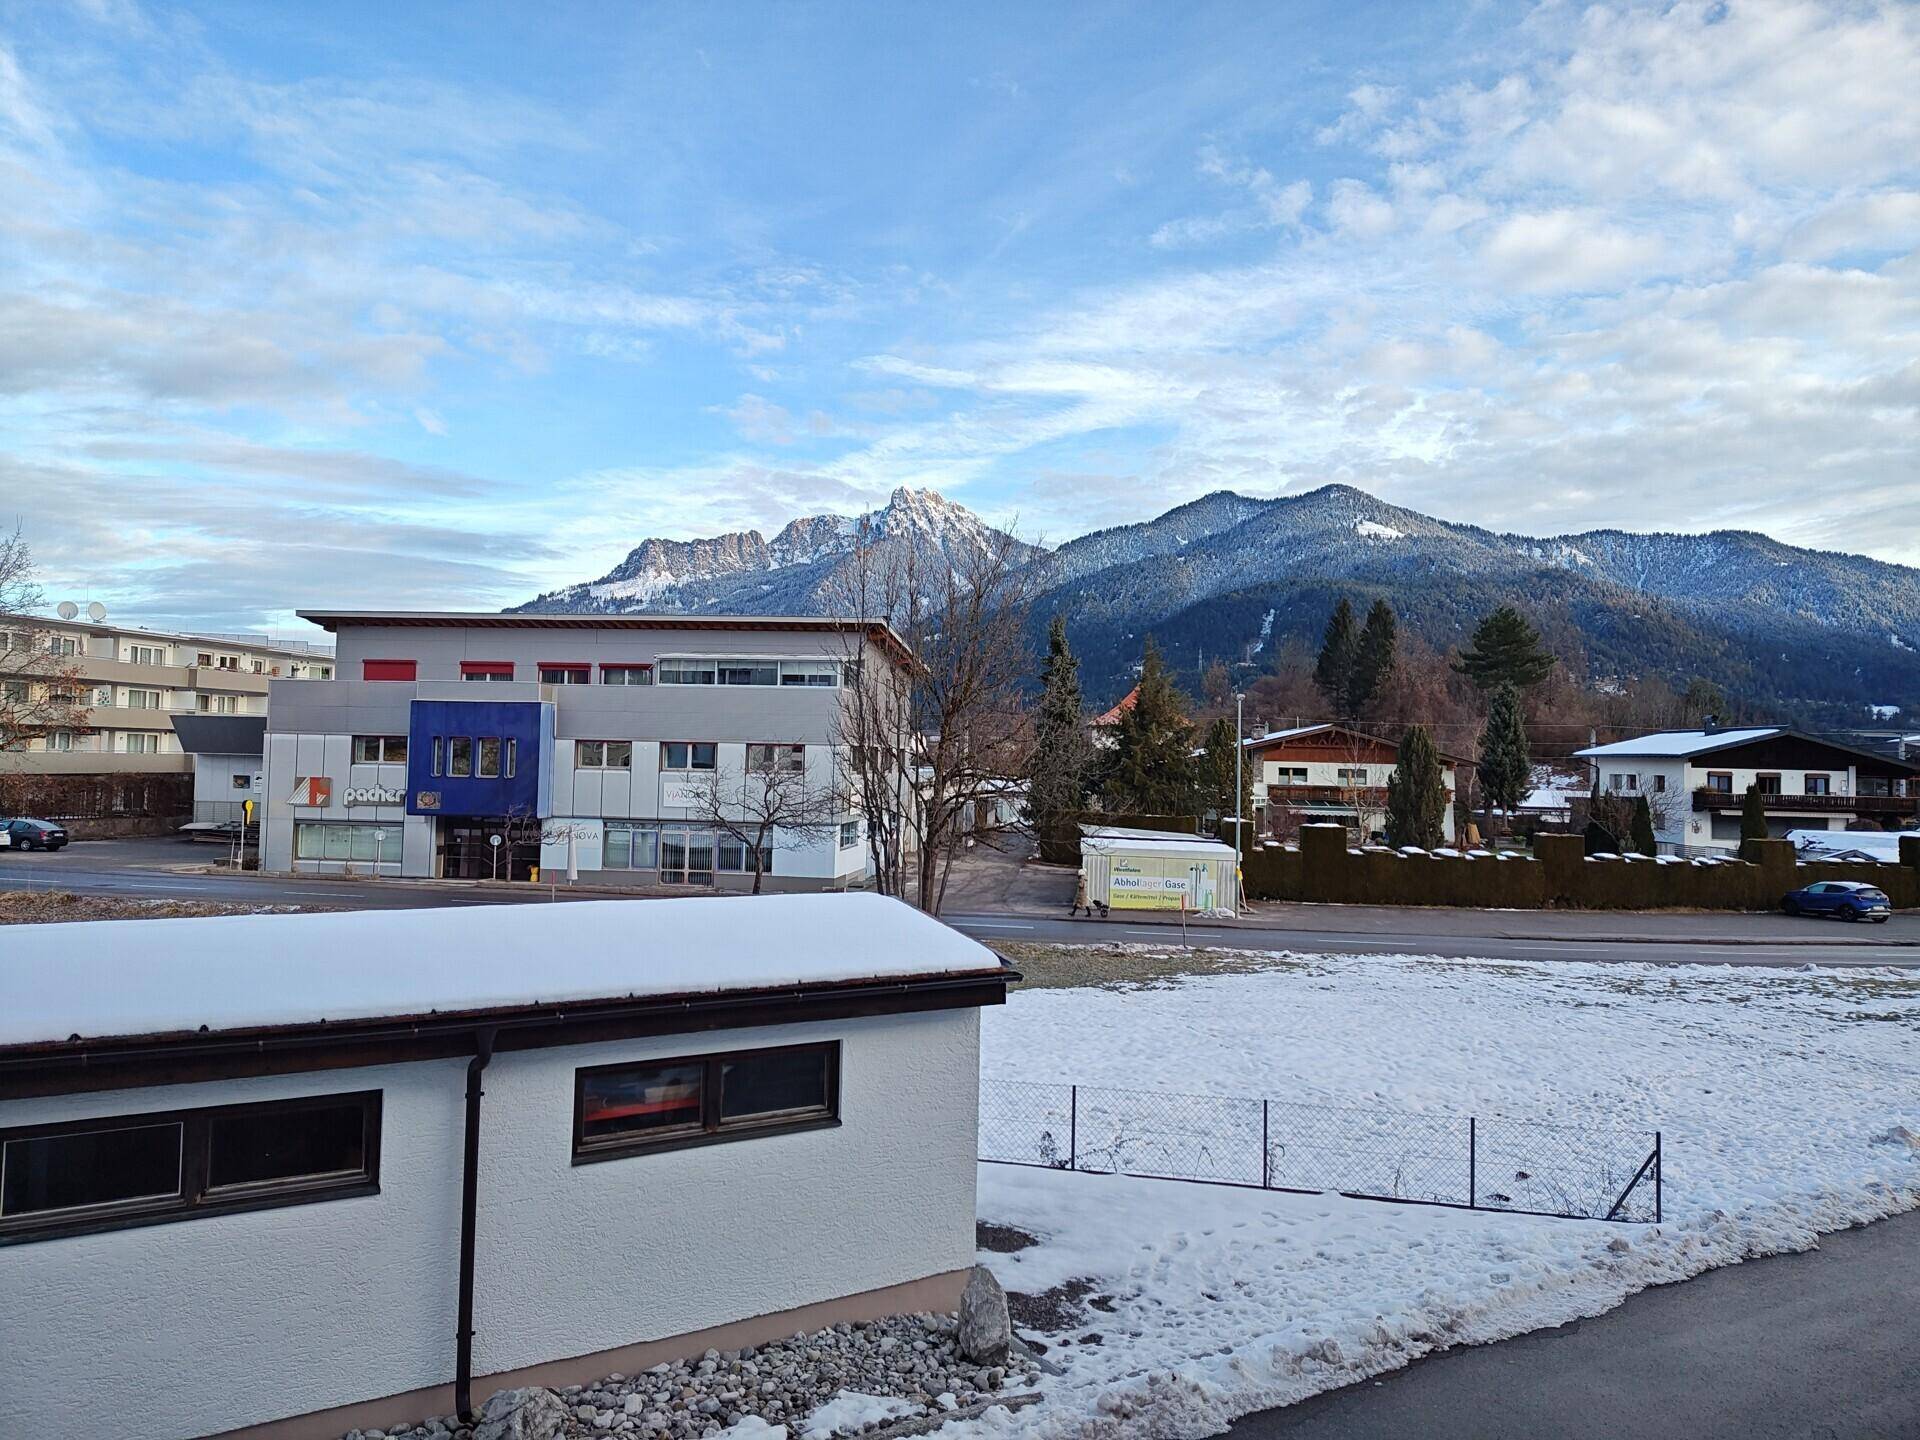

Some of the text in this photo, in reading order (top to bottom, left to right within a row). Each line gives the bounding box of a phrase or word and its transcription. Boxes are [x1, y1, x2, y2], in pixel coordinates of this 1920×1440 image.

[343, 784, 406, 806] pacher
[1113, 877, 1186, 889] Abhollager Gase
